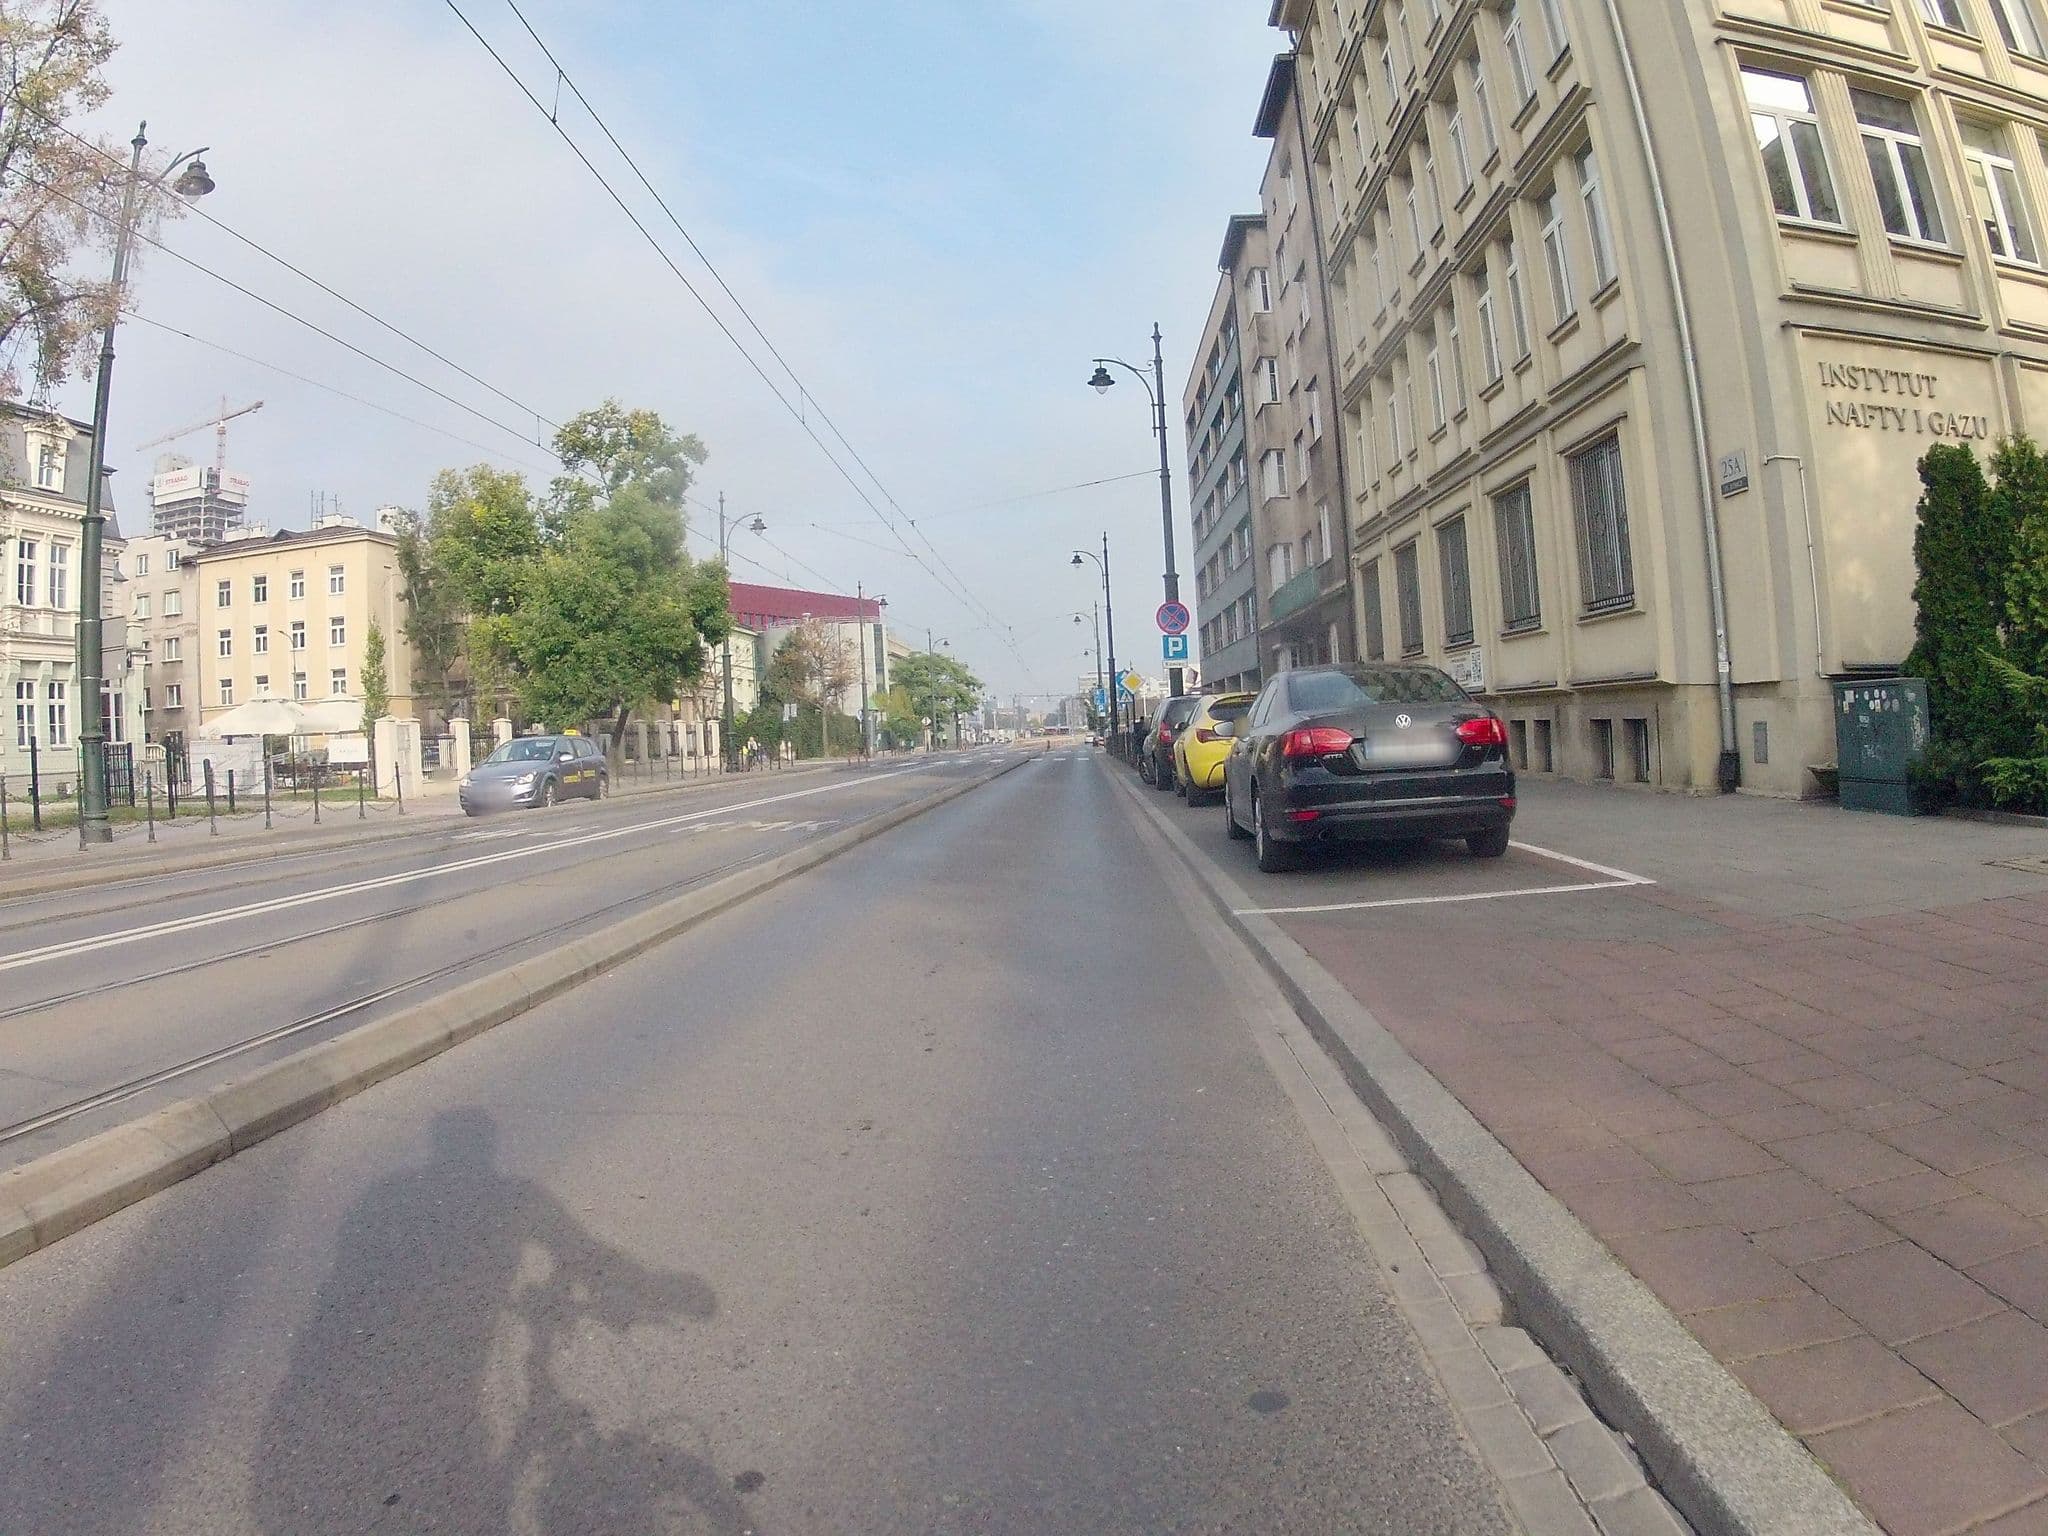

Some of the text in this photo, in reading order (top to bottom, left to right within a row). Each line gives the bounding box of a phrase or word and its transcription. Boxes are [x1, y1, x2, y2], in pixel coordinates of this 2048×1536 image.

[1818, 361, 1937, 398] INSTYTUT
[1827, 400, 1988, 440] NAFTY I GAZU
[1168, 637, 1183, 657] P
